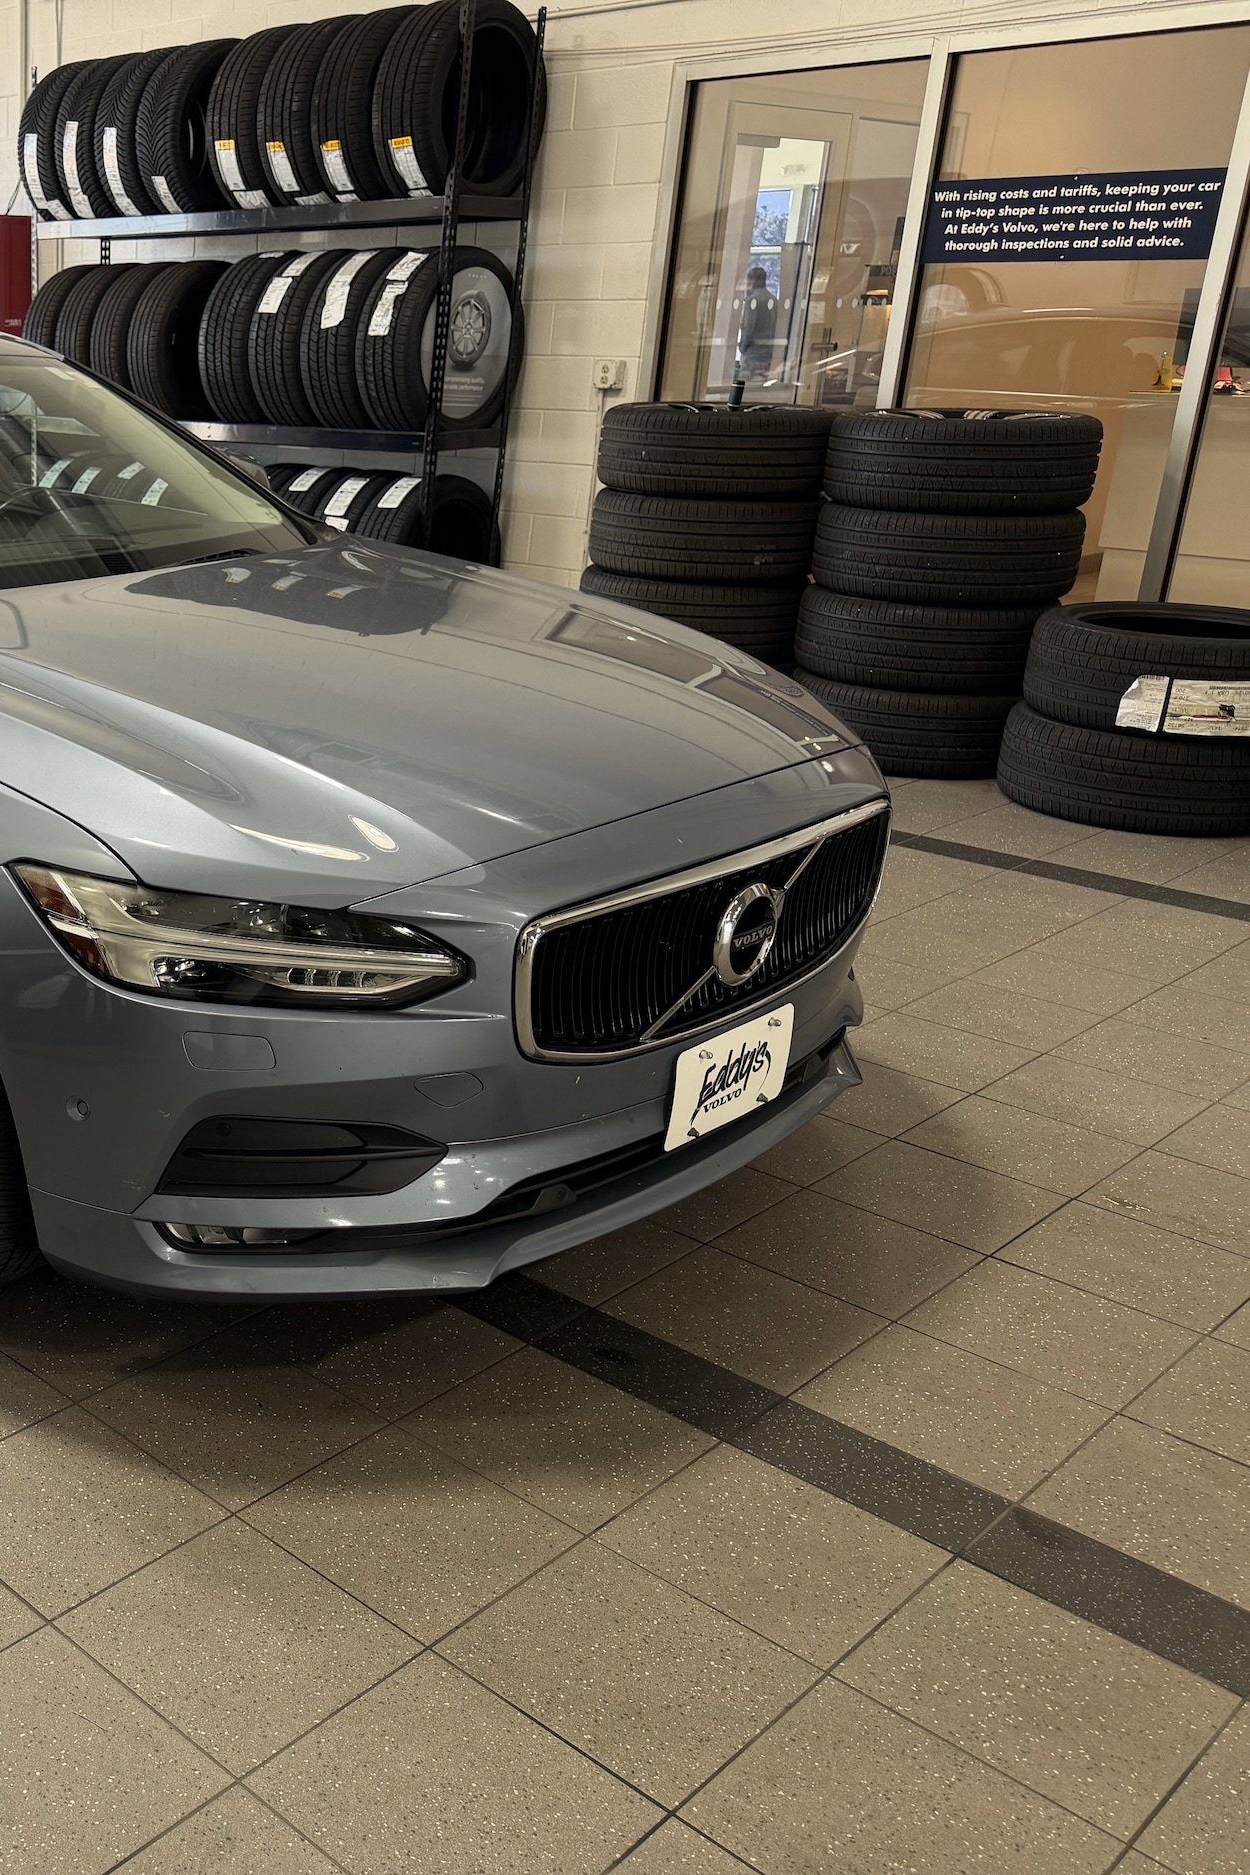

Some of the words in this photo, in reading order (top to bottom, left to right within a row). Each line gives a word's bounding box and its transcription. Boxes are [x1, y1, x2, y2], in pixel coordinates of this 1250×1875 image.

[934, 190, 960, 202] With
[963, 189, 997, 203] rising
[1000, 187, 1029, 200] costs
[1032, 185, 1057, 198] and
[1060, 183, 1102, 198] tariffs,
[1105, 181, 1159, 197] keeping
[1162, 182, 1195, 196] your
[1198, 180, 1221, 192] car
[941, 207, 953, 219] in
[955, 205, 995, 220] tip-top
[998, 204, 1035, 219] shape
[1038, 203, 1050, 216] is
[1052, 203, 1085, 215] more
[1088, 201, 1132, 214] crucial
[1134, 200, 1166, 212] than
[1169, 199, 1204, 211] ever.
[944, 223, 958, 235] At
[960, 222, 999, 236] Eddy's
[1001, 221, 1039, 235] Volvo,
[1042, 220, 1076, 233] we're
[1078, 220, 1109, 232] here
[1112, 219, 1126, 231] to
[1128, 218, 1160, 233] help
[1162, 217, 1192, 229] with
[944, 239, 999, 252] thorough
[1001, 238, 1070, 252] inspections
[1072, 237, 1099, 249] and
[1101, 236, 1133, 249] solid
[1136, 235, 1185, 248] advice.
[733, 925, 773, 948] VOLVO
[700, 1040, 769, 1101] Eddy's
[703, 1088, 742, 1113] VOLVO
